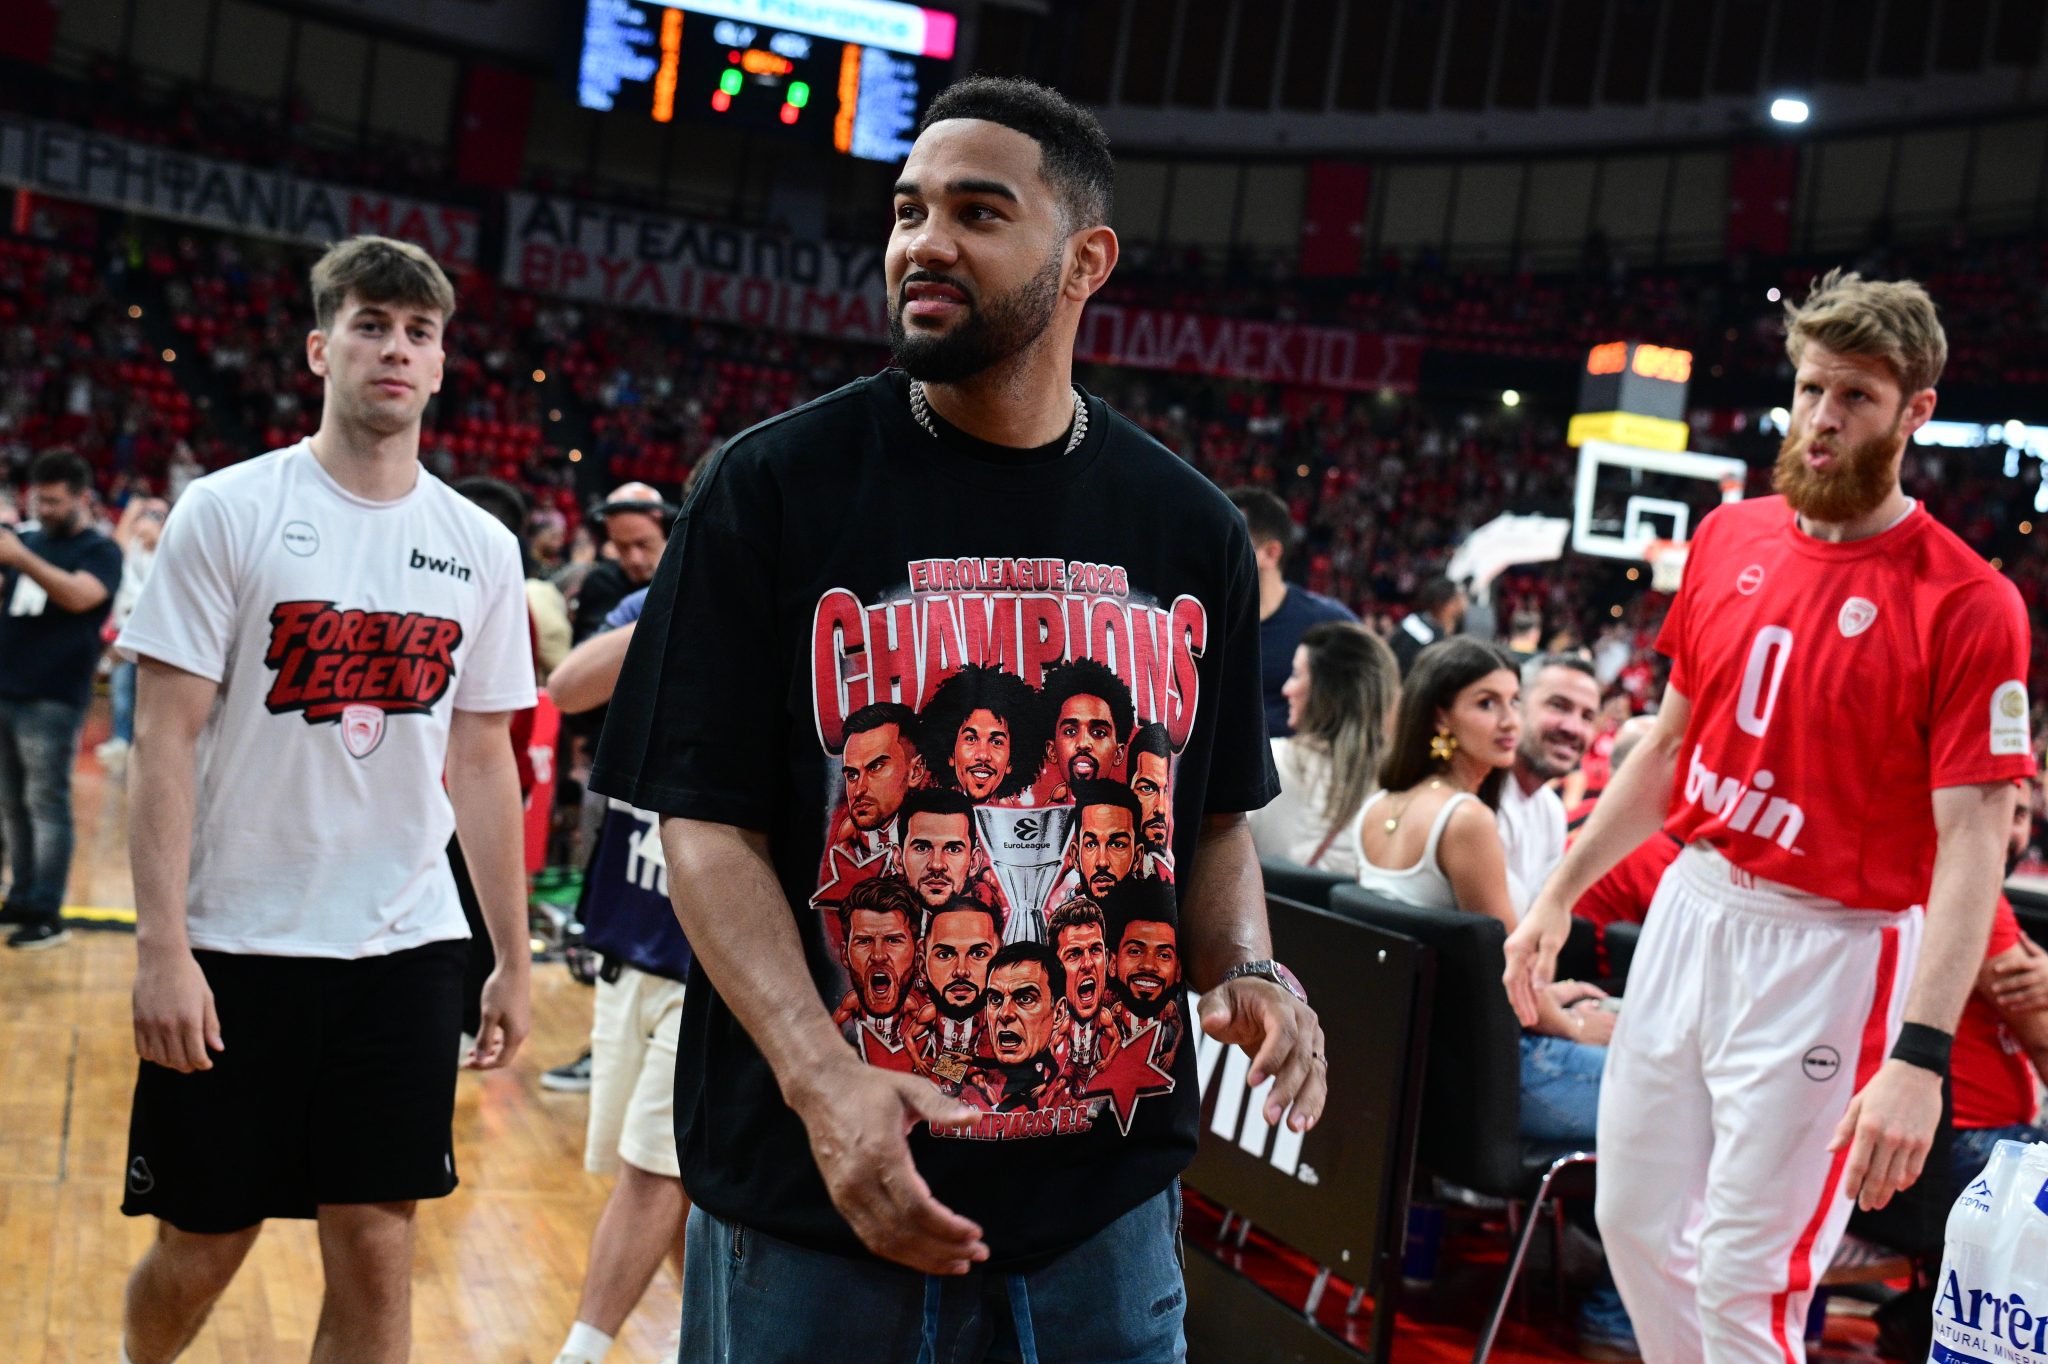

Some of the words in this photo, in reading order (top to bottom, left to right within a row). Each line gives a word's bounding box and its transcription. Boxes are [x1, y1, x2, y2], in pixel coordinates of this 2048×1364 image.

[410, 548, 472, 582] bwin
[908, 557, 1067, 594] EUROLEAGUE
[1068, 561, 1129, 597] 2026
[267, 600, 460, 668] FOREVER
[268, 646, 449, 704] LEGEND
[811, 587, 1208, 759] CHAMPIONS
[1736, 624, 1793, 738] 0
[1684, 743, 1805, 850] bwin
[1003, 842, 1051, 850] EuroLeague
[951, 1032, 966, 1043] 94
[1057, 1105, 1093, 1134] B.C.
